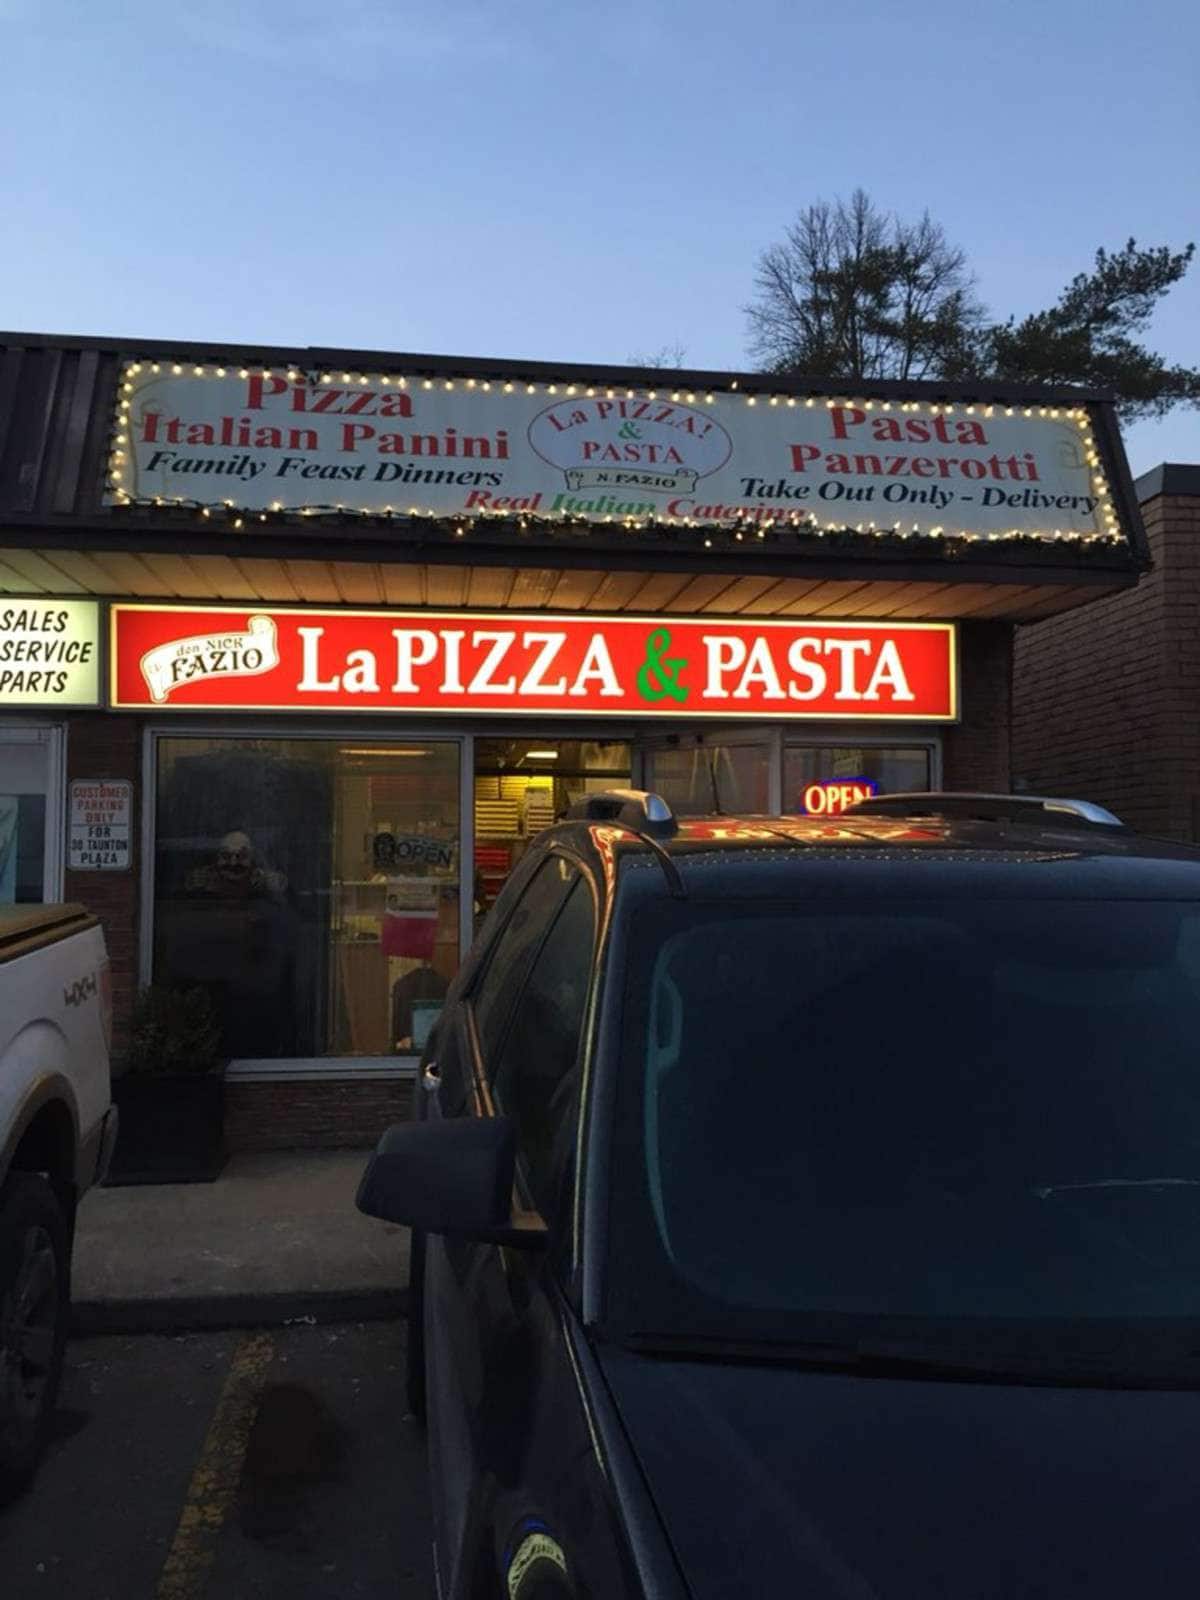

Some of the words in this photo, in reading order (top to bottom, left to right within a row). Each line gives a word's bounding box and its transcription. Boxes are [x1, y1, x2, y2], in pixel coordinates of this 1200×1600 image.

[243, 374, 415, 418] Pizza
[547, 406, 588, 433] La
[596, 400, 714, 439] PIZZA!
[618, 421, 643, 440] &
[830, 406, 989, 446] Pasta
[140, 412, 320, 451] Italian
[340, 422, 511, 460] Panini
[582, 441, 684, 465] PASTA
[790, 444, 1040, 482] Panzerotti
[145, 451, 266, 481] Family
[275, 457, 366, 480] Feast
[373, 462, 502, 486] Dinners
[464, 490, 543, 511] Real
[550, 494, 657, 515] Italian
[740, 477, 811, 501] Take
[818, 480, 874, 502] Out
[883, 482, 955, 509] Only
[981, 487, 1101, 516] Delivery
[0, 609, 69, 633] SALES
[0, 640, 93, 663] SERVICE
[205, 637, 243, 652] NICK
[171, 648, 263, 682] FAZIO
[297, 627, 380, 692] La
[391, 628, 625, 698] PIZZA
[636, 627, 690, 703] &
[702, 634, 914, 702] PASTA
[0, 671, 69, 693] PARTS
[85, 812, 114, 822] ONLY
[88, 826, 111, 837] FOR
[88, 839, 127, 850] TAUNTON
[397, 842, 452, 869] OPEN
[81, 852, 117, 864] PLAZA
